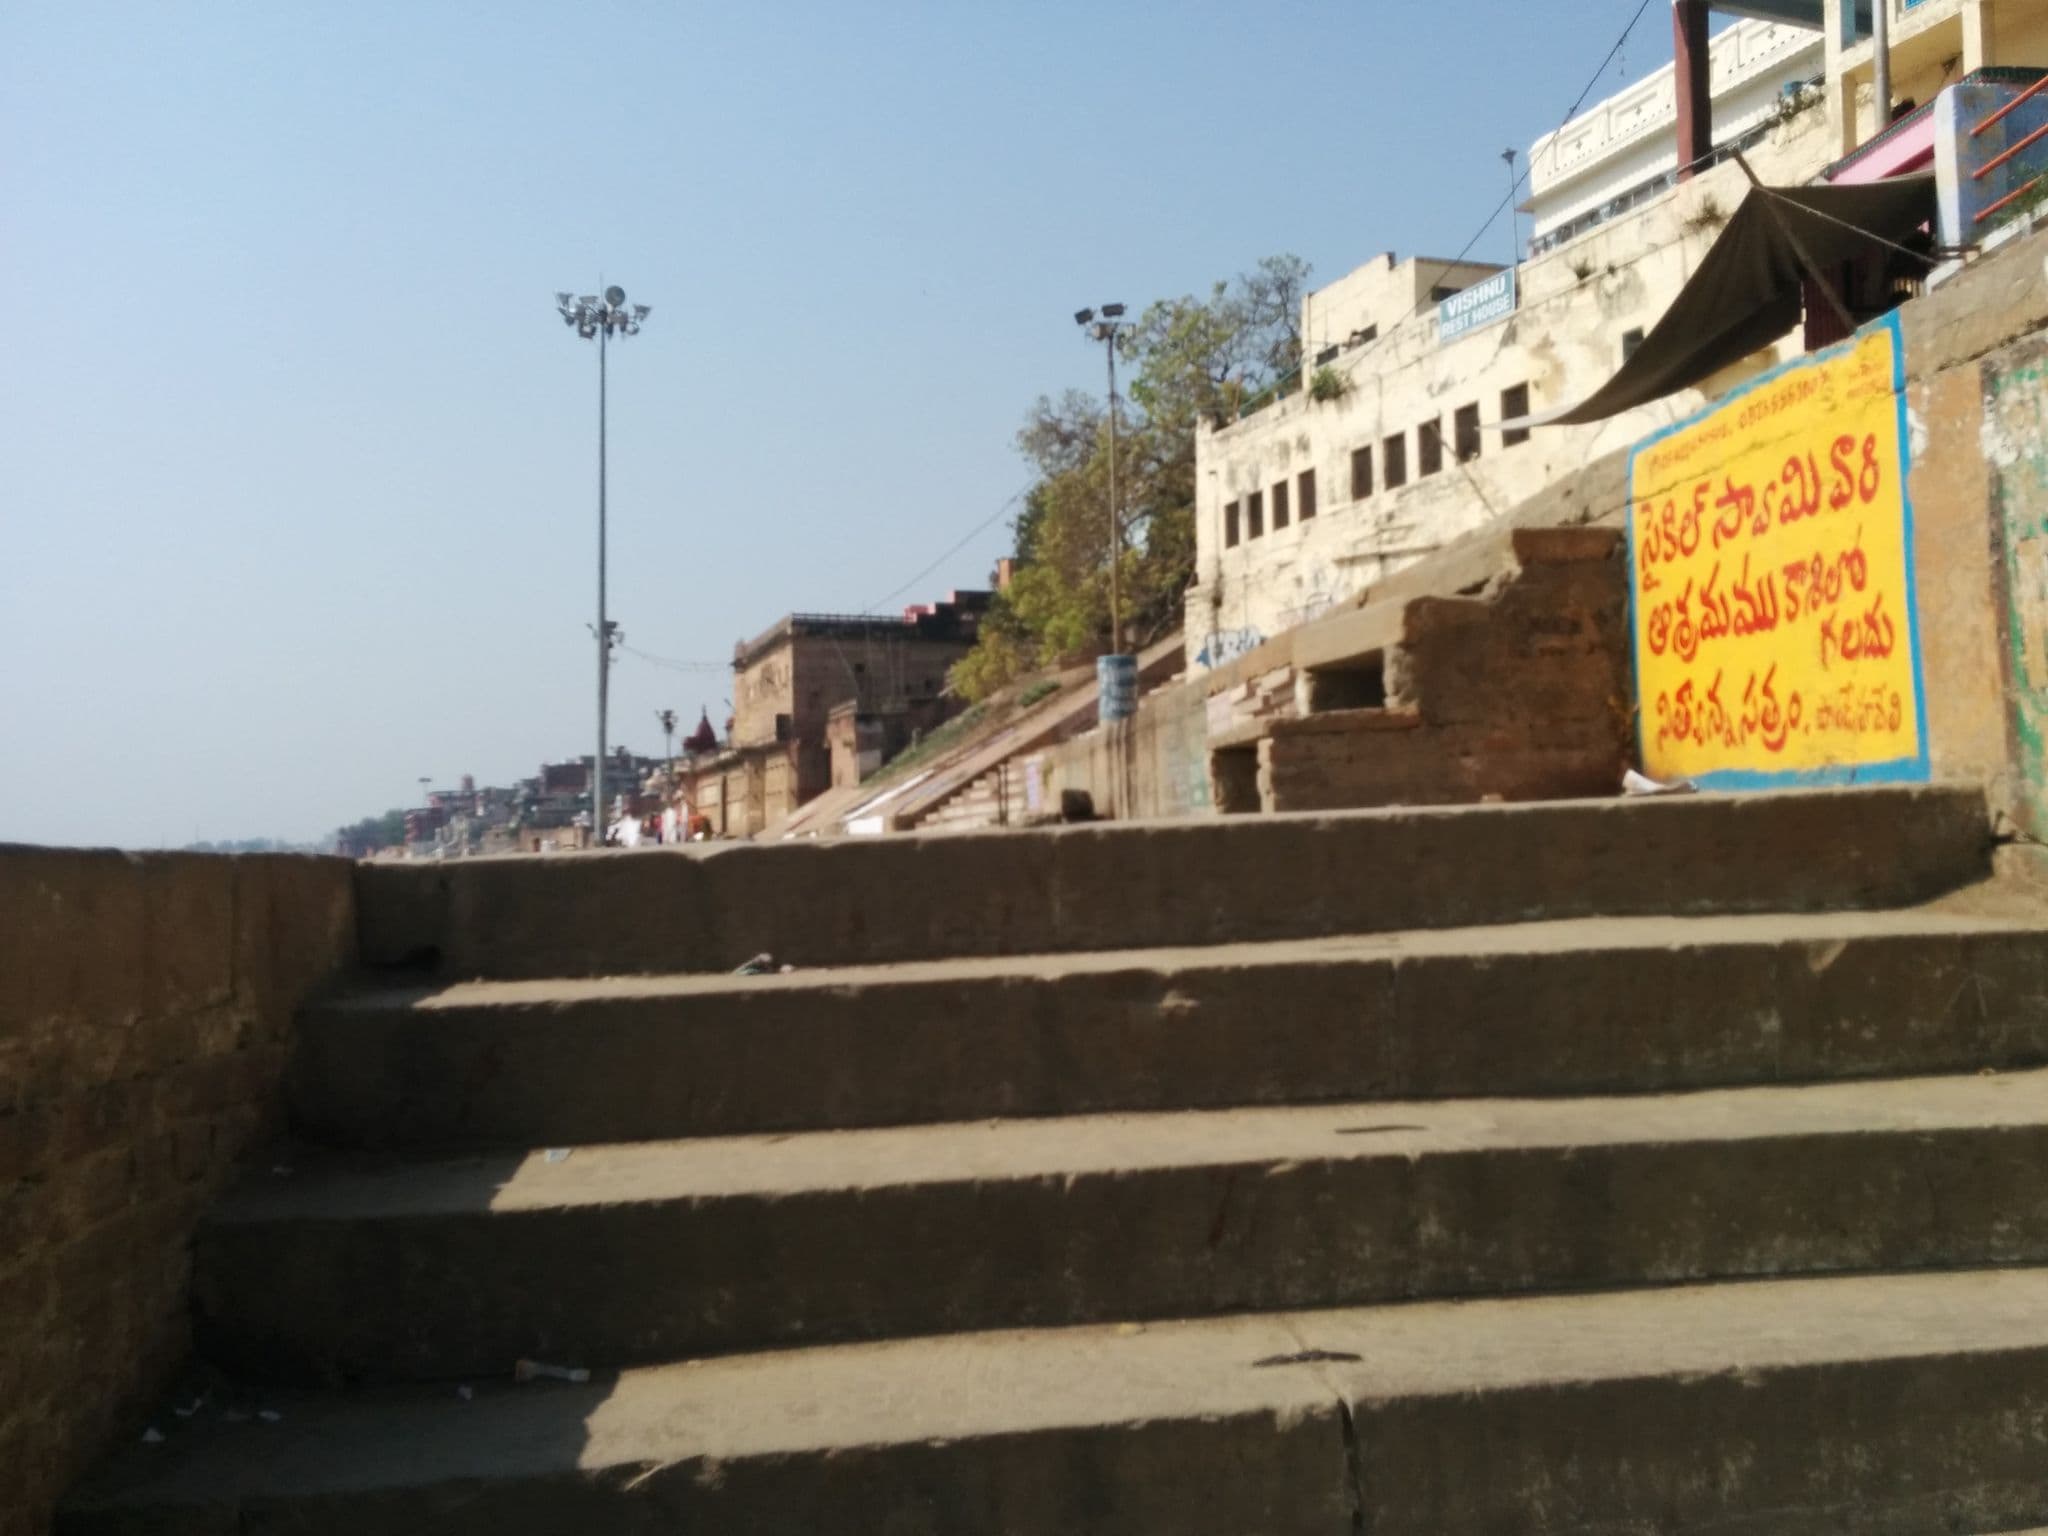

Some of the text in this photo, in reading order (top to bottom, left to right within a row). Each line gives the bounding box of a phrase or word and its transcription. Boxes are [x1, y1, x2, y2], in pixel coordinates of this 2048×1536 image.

[1441, 293, 1510, 339] REST HOUSE
[1446, 275, 1506, 317] VISHNU
